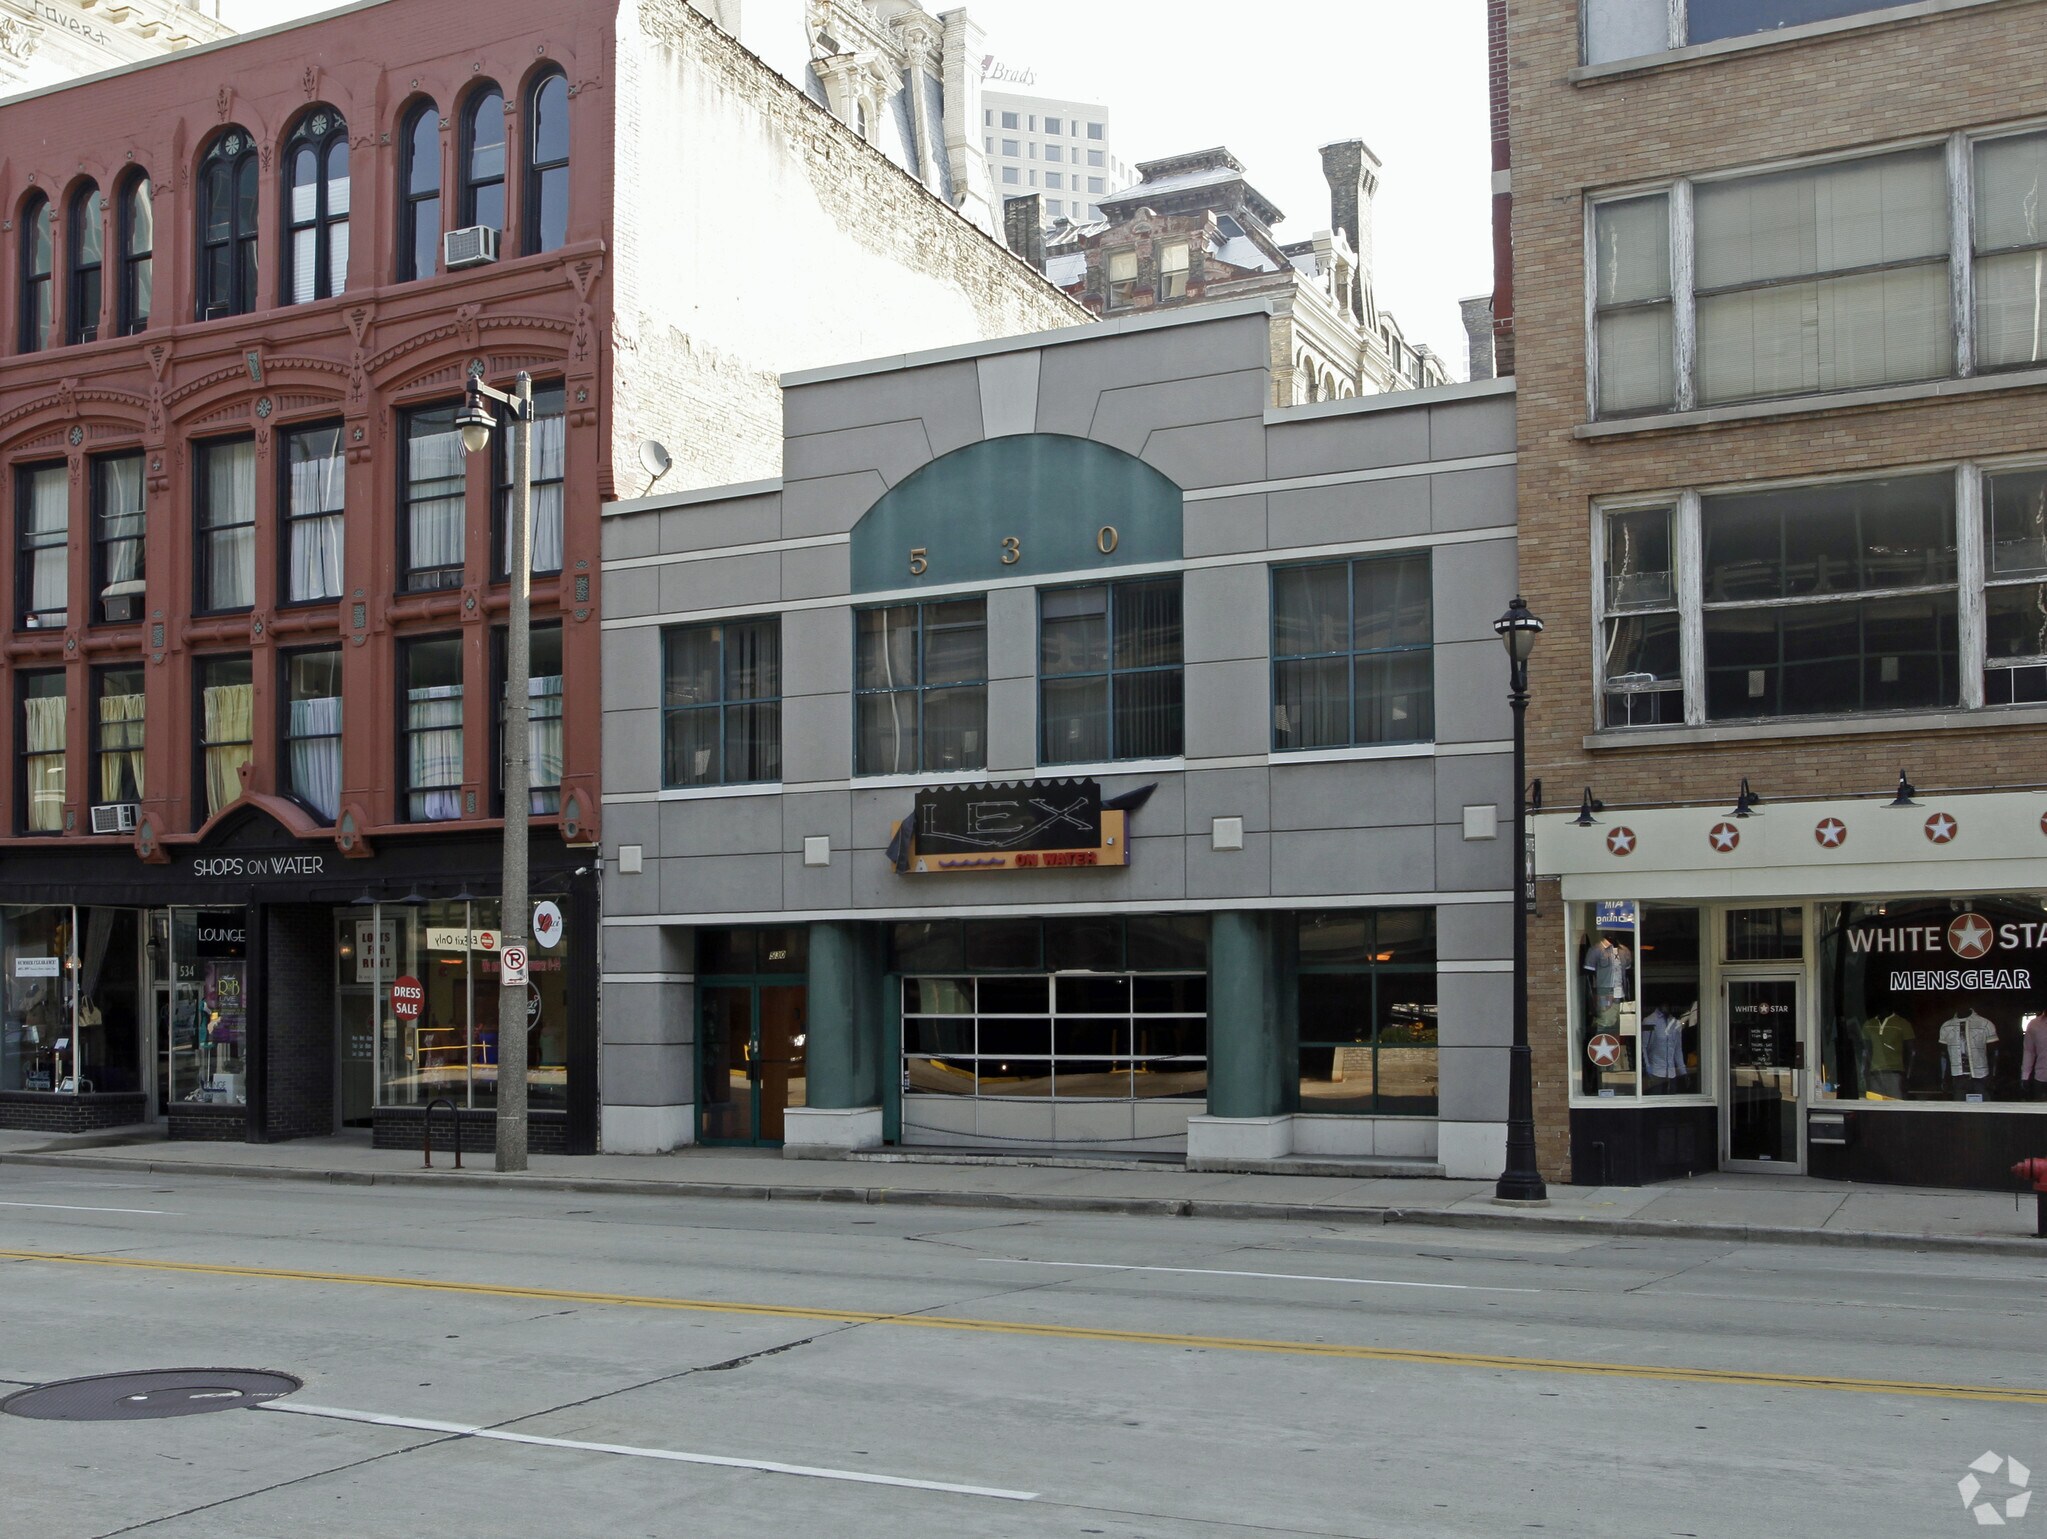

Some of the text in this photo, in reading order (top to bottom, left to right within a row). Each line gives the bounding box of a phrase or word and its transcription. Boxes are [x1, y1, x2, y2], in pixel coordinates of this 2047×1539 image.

[921, 797, 1094, 847] LEX
[1015, 851, 1097, 867] ON WATER
[193, 856, 324, 876] SHOPS ON WATER
[198, 928, 246, 942] LOUNGE
[361, 932, 391, 943] LOTS
[1847, 926, 1942, 953] WHITE
[367, 945, 386, 955] FR
[180, 965, 194, 977] 534
[1890, 969, 2032, 991] MENSGEAR
[394, 986, 421, 999] DRESS
[396, 1002, 418, 1015] SALE
[1734, 1005, 1788, 1013] WHITE STAR
